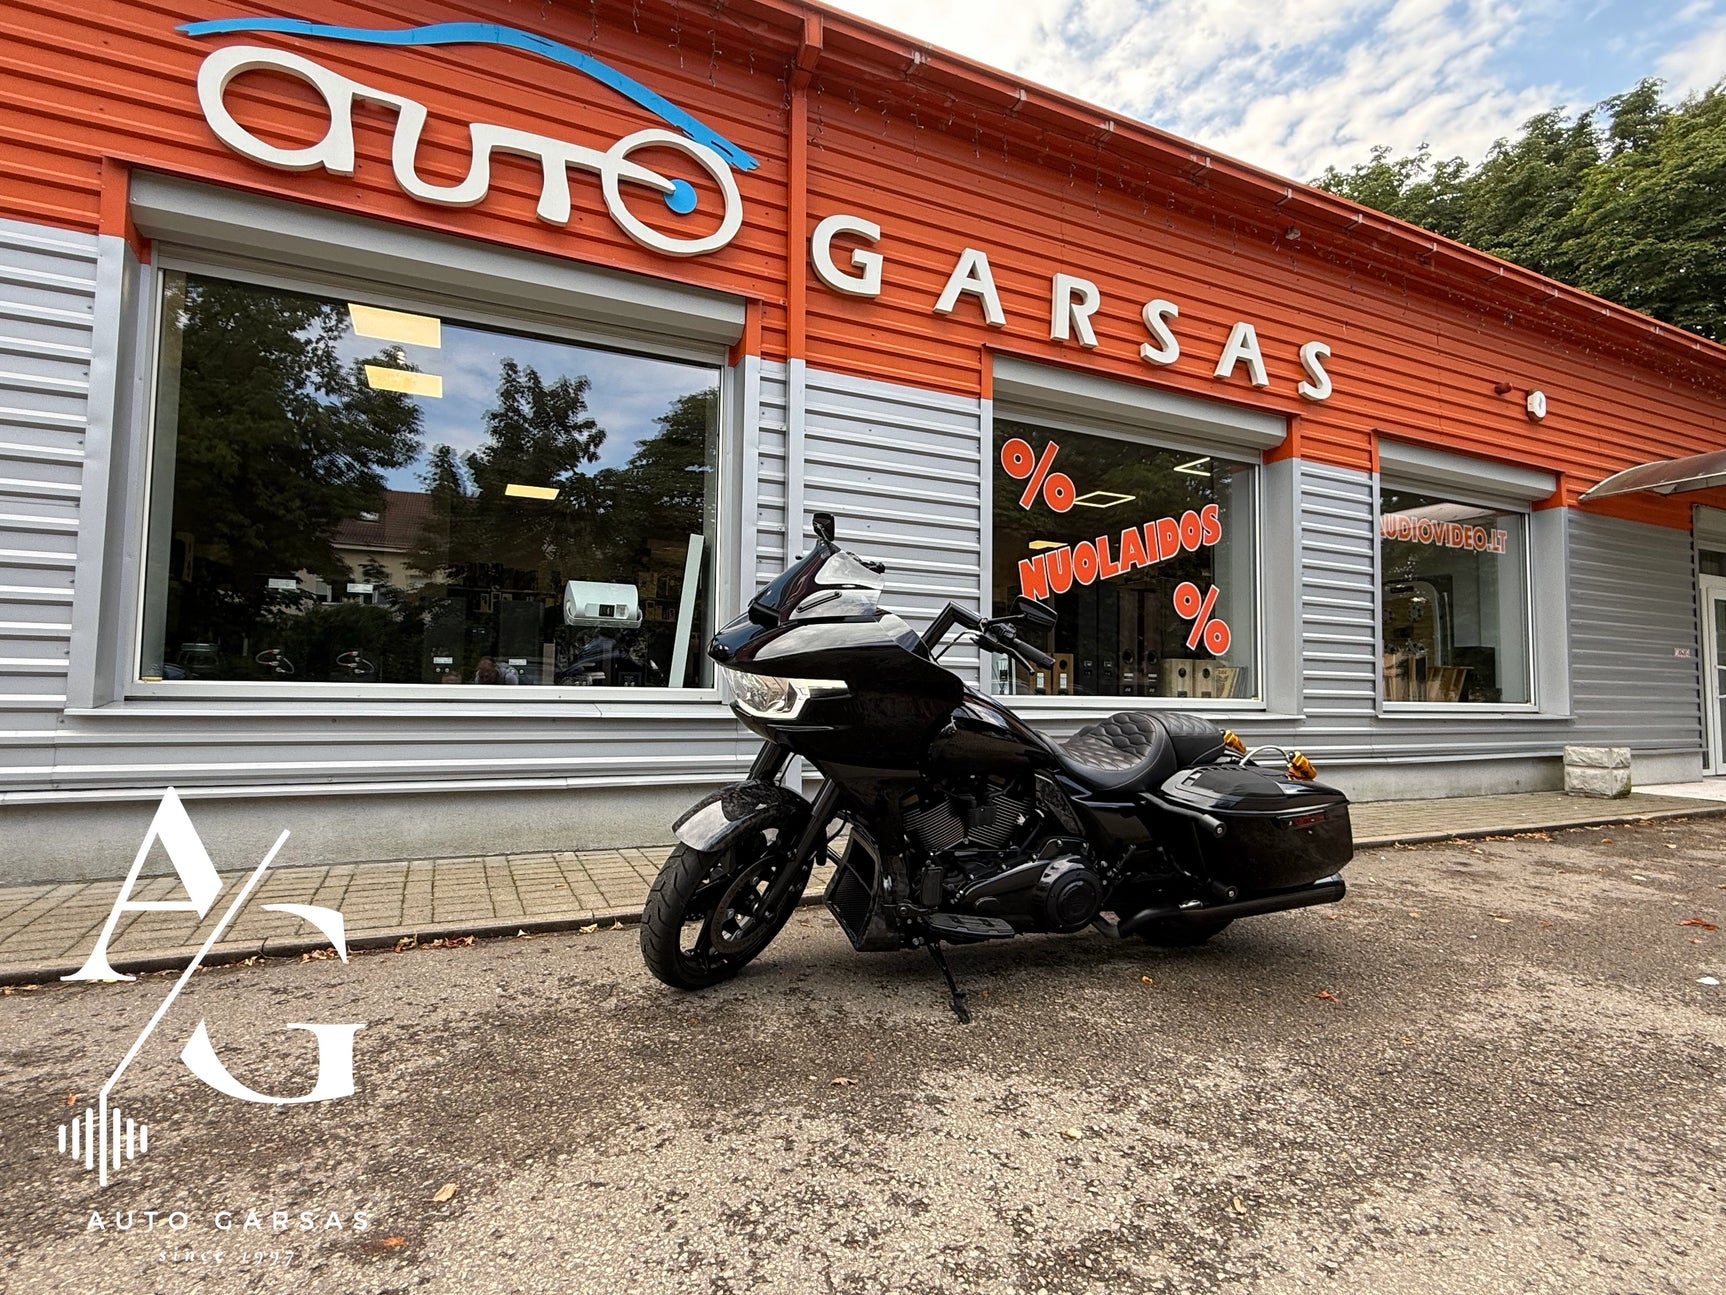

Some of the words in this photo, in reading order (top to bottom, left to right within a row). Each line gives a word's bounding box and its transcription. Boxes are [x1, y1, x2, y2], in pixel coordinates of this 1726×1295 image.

[810, 214, 1333, 402] GARSAS
[1001, 438, 1076, 513] %
[1019, 504, 1222, 601] NUOLAIDOS
[1173, 581, 1231, 656] %
